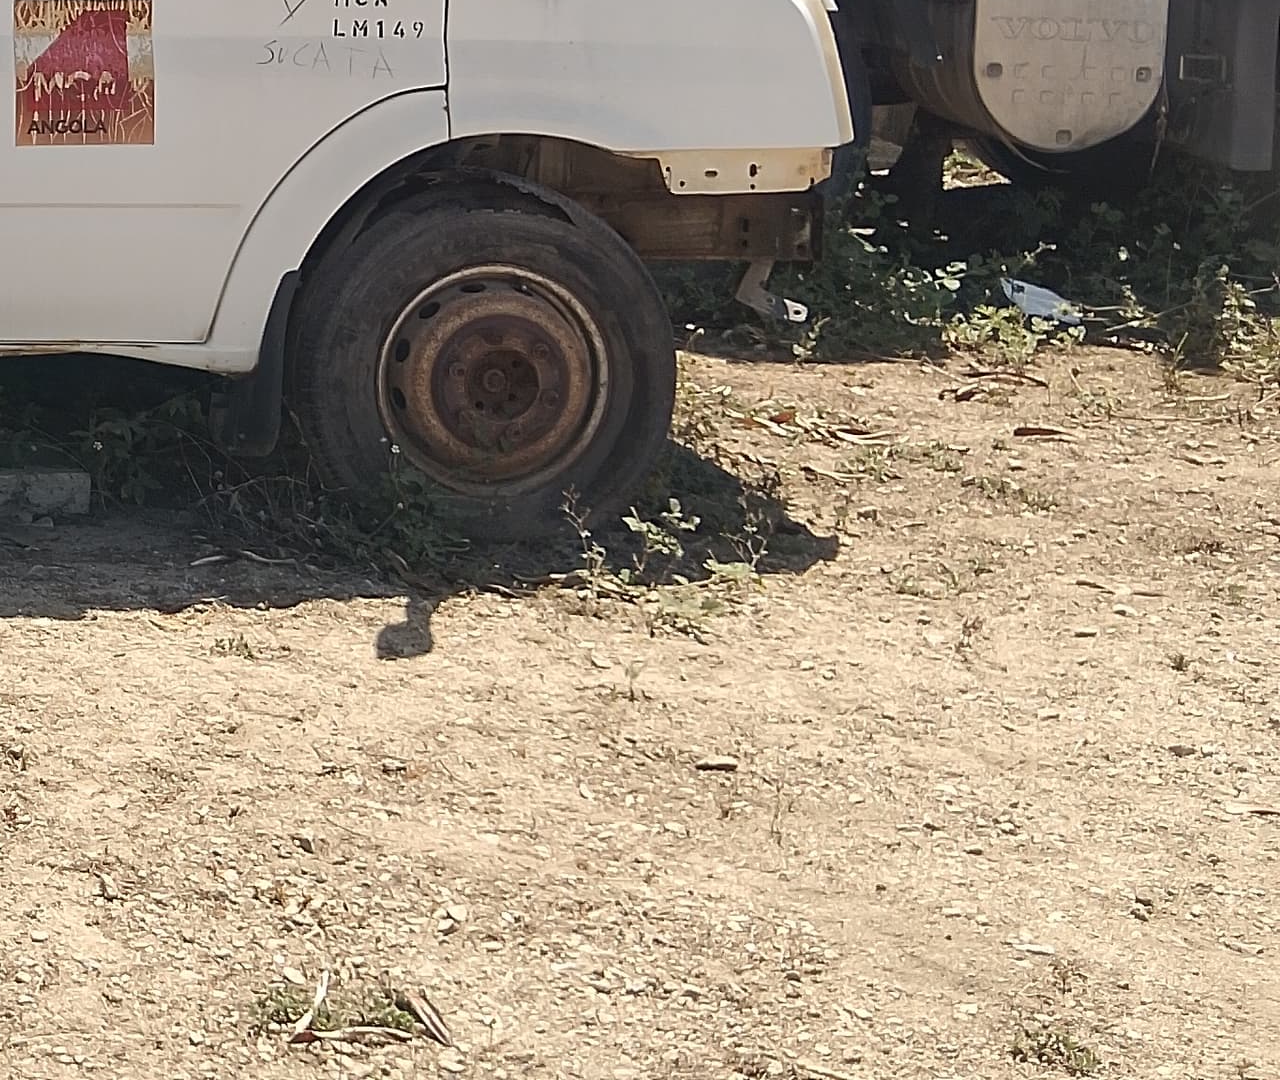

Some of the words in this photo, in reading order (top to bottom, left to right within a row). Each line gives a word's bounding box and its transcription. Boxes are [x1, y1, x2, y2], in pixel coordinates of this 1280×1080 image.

[333, 19, 424, 39] LM149
[992, 17, 1156, 44] VOLVO
[27, 119, 108, 135] ANGOLA
